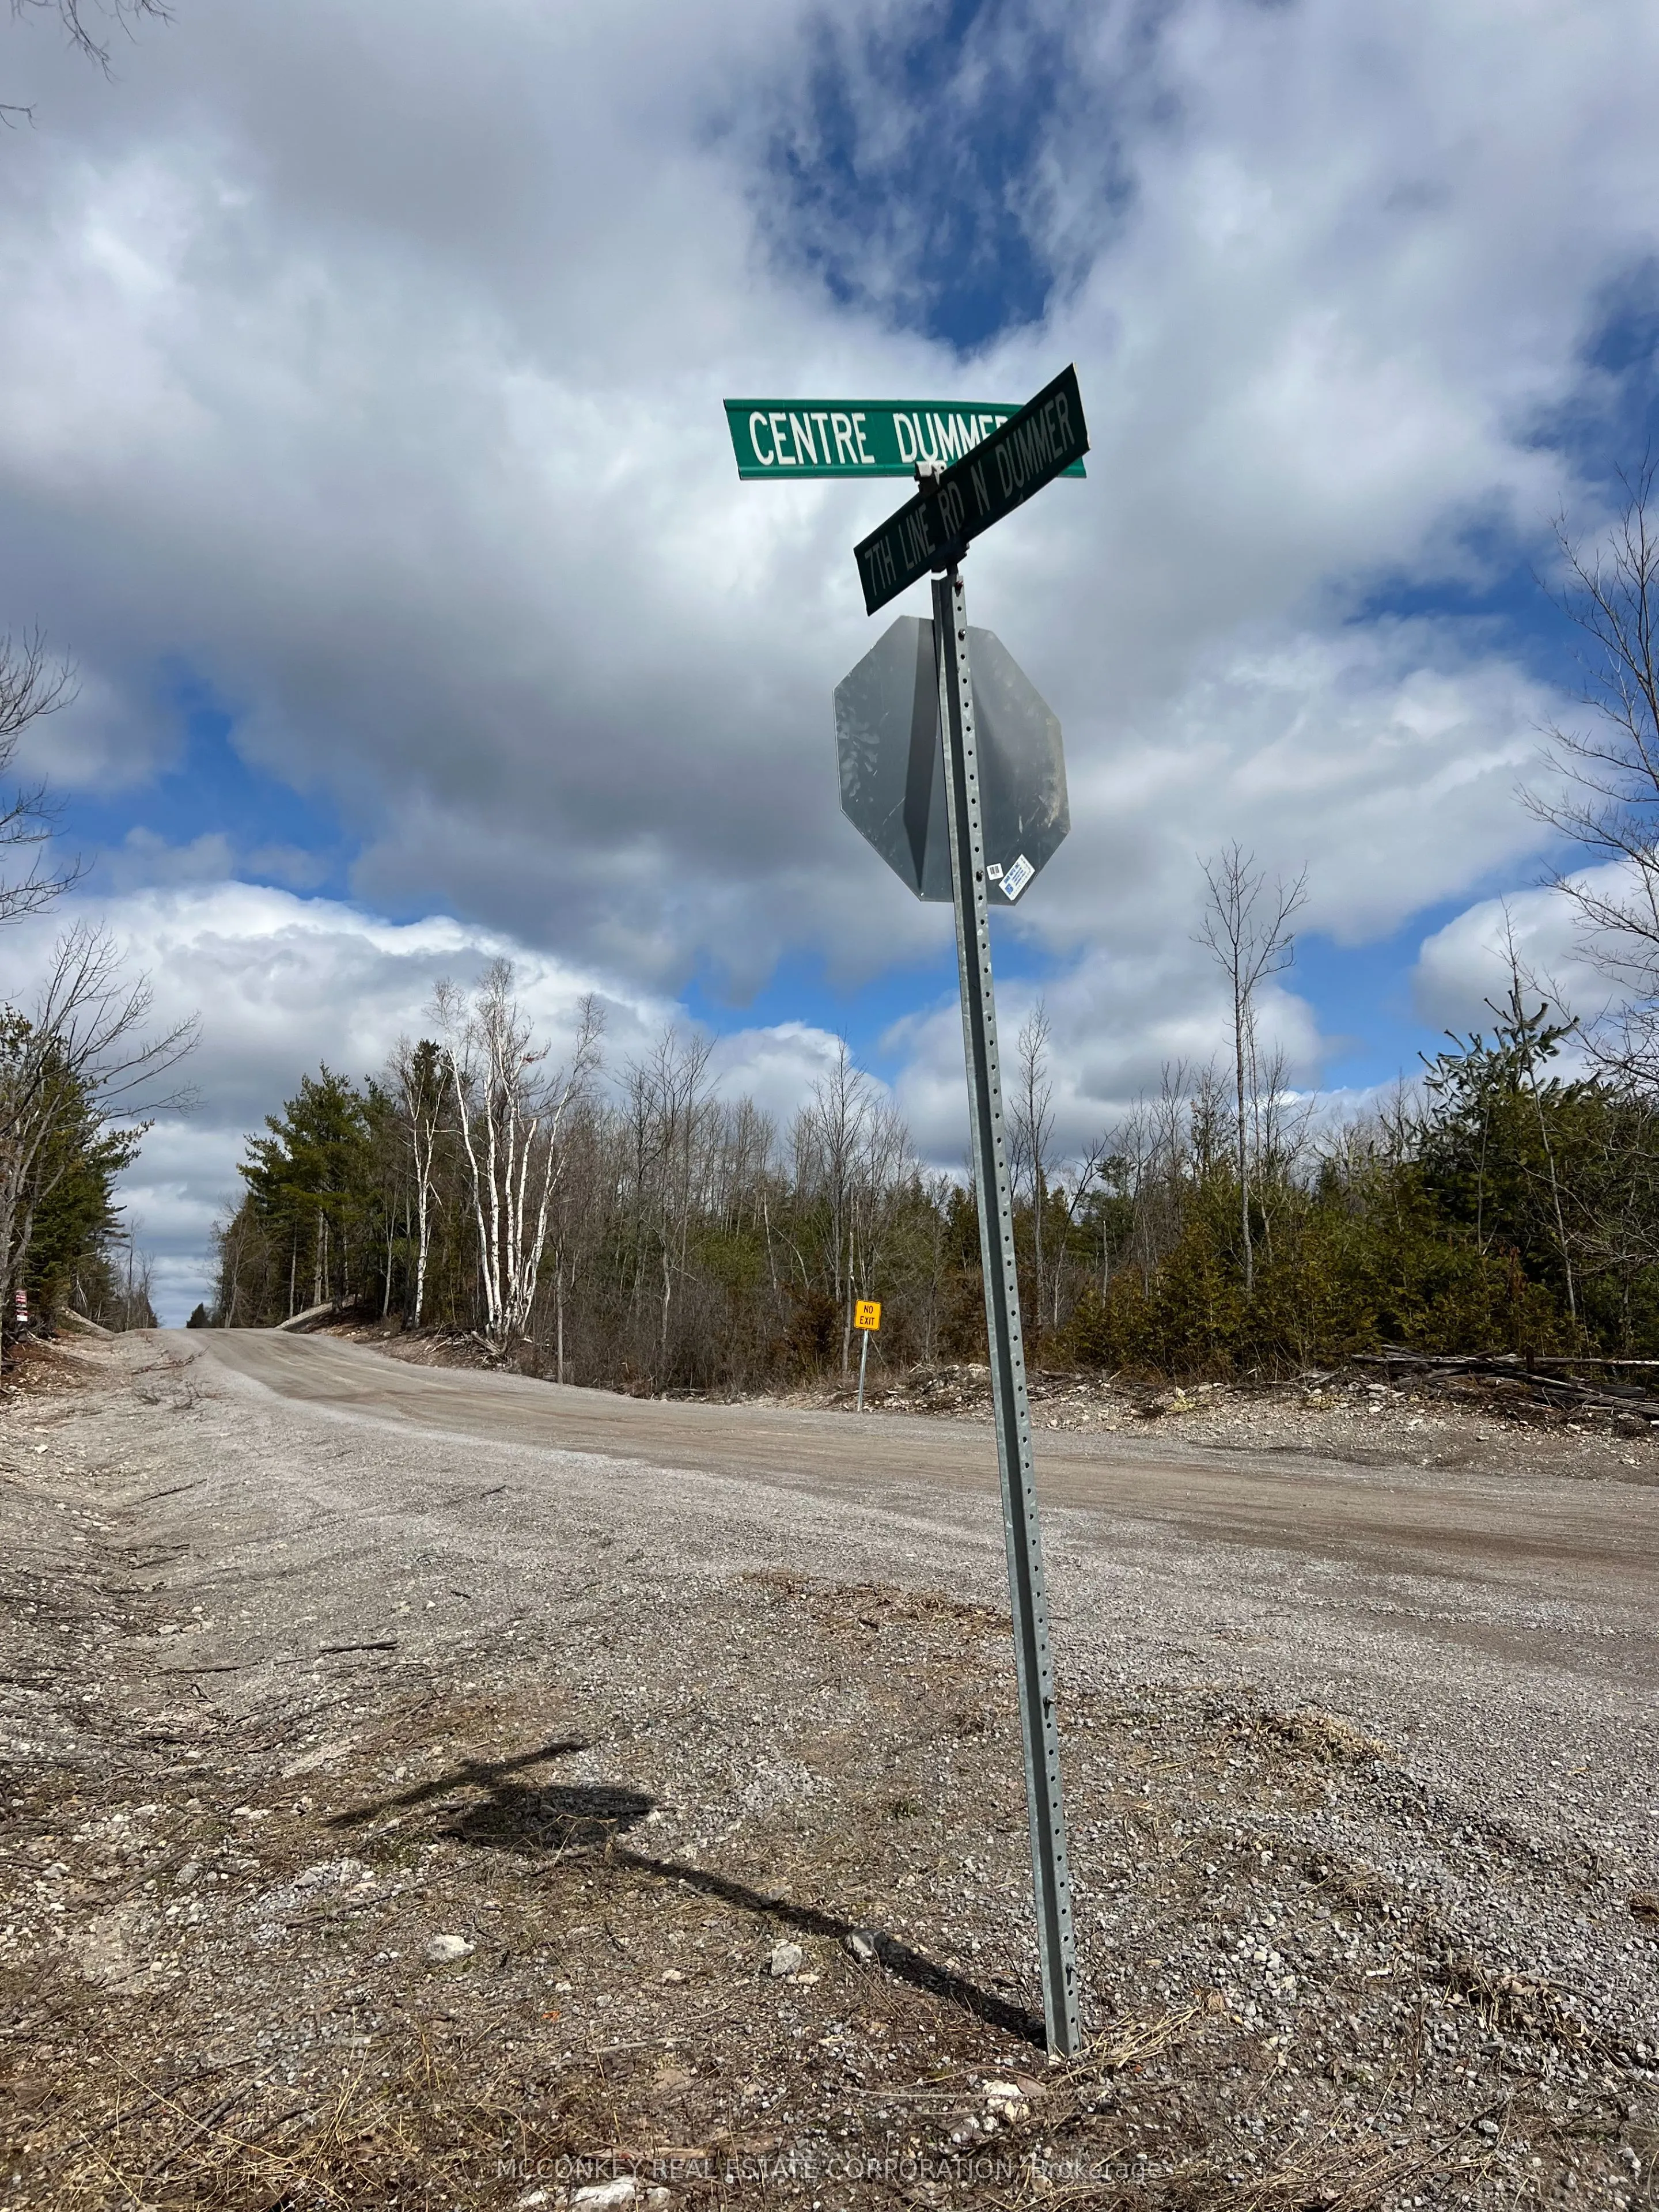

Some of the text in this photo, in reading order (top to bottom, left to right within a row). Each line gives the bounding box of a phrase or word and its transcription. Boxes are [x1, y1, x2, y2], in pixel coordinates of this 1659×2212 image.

[749, 411, 1008, 465] CENTRE DUMME
[865, 391, 1075, 596] 7TH LINE RD N DUMMER
[859, 1316, 875, 1325] EXIT
[864, 1305, 873, 1314] NO
